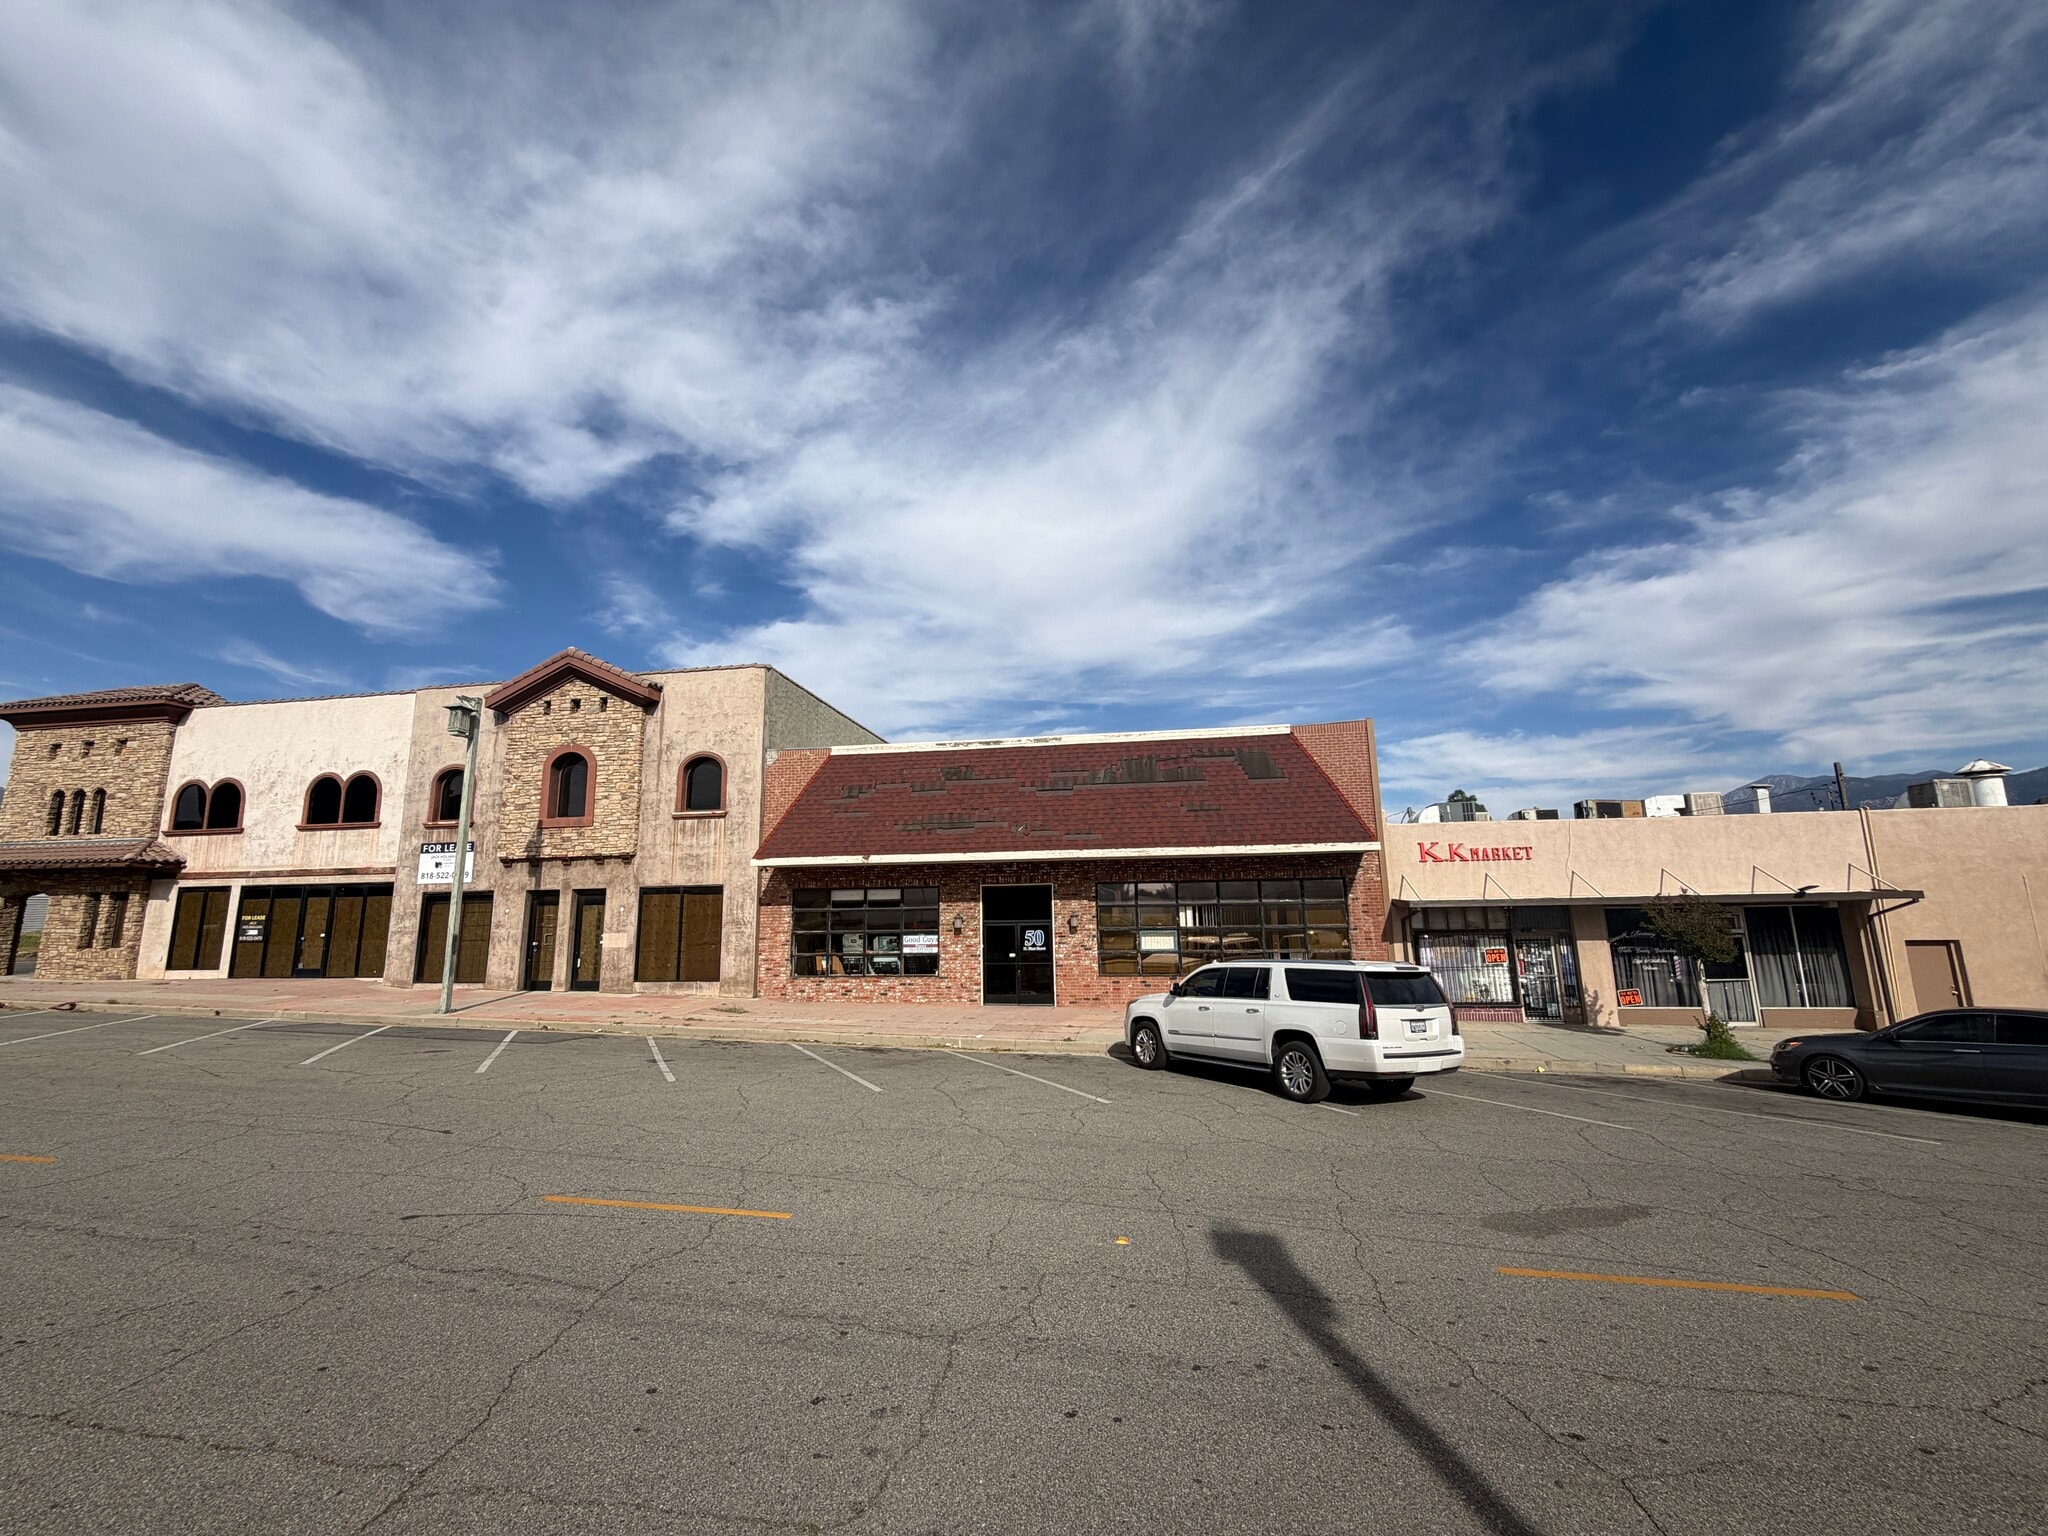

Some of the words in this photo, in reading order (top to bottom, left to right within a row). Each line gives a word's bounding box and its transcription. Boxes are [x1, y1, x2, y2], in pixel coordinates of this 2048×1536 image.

[422, 844, 442, 853] FOR
[444, 843, 473, 852] LEE
[1469, 846, 1532, 862] MARKET
[420, 871, 469, 880] 818-522-09
[922, 936, 938, 945] Guys
[1024, 930, 1045, 946] 50
[1486, 954, 1506, 963] OPEN
[1620, 994, 1641, 1005] OPEN
